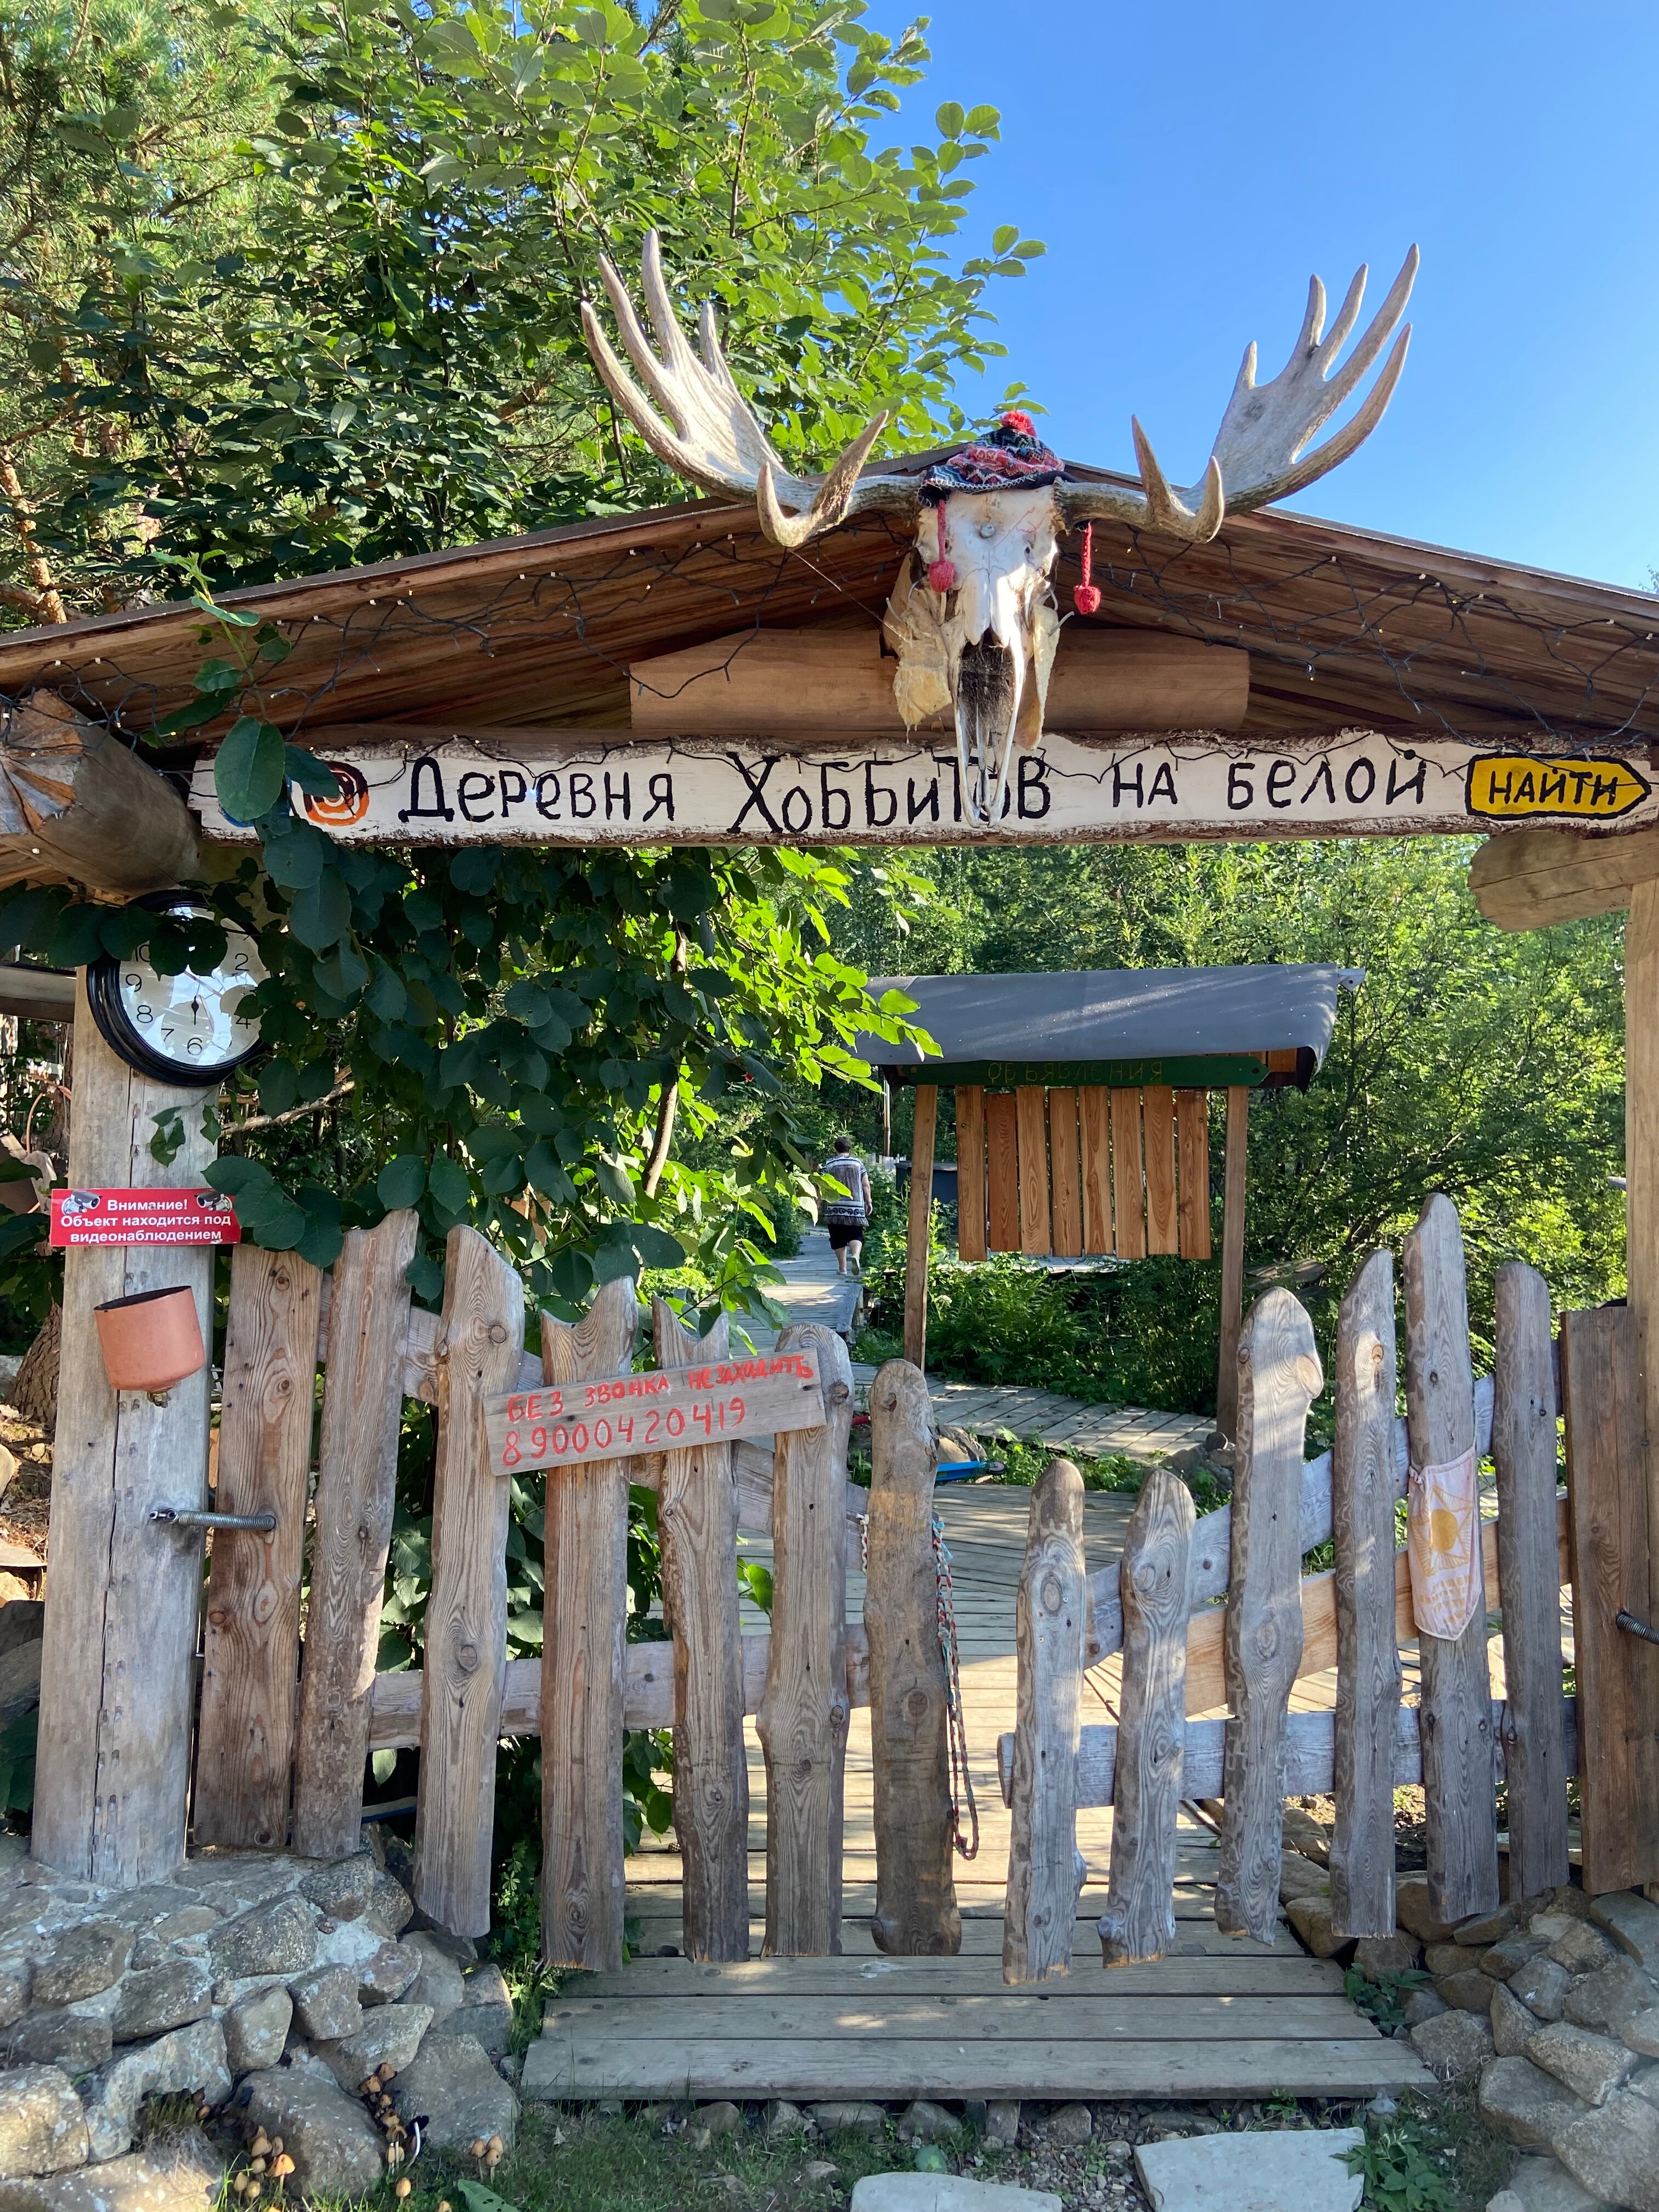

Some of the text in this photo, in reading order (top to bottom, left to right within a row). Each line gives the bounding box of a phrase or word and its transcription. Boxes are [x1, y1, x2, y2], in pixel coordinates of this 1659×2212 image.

[1488, 768, 1618, 806] НАЙТИ
[234, 952, 250, 972] 2
[125, 973, 142, 992] 9
[137, 1005, 154, 1024] 8
[187, 1037, 203, 1056] 6
[107, 1199, 188, 1212] Внимание!
[60, 1215, 232, 1228] Объект находится под
[70, 1229, 222, 1244] видеонаблюдением
[507, 1390, 564, 1423] БЕЗ
[584, 1373, 670, 1408] ЗВОНКА
[502, 1397, 745, 1466] 89000420419
